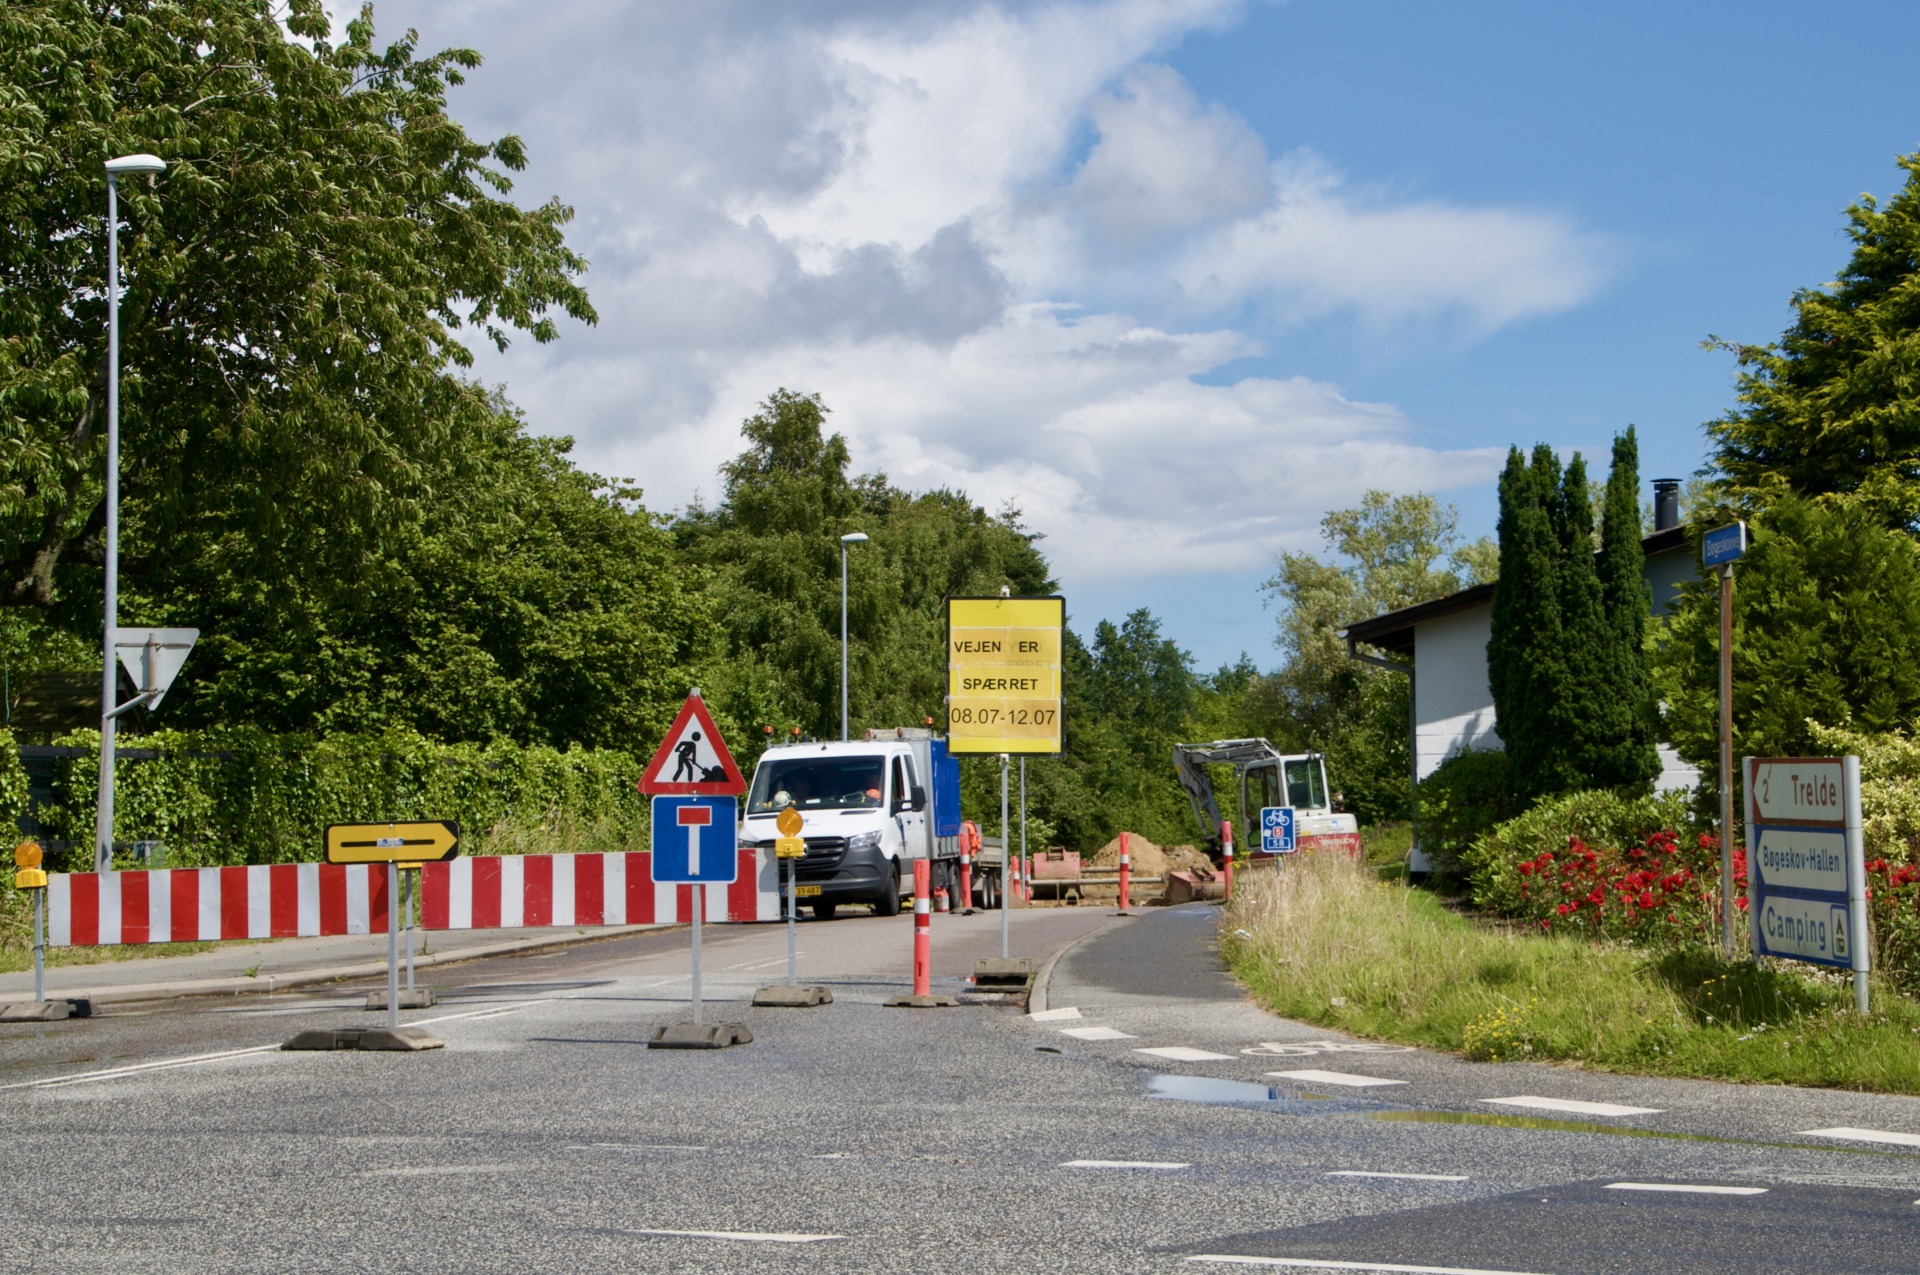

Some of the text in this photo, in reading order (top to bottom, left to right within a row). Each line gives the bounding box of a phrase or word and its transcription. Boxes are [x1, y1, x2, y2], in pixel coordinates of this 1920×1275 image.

[954, 641, 1039, 653] VEJEN ER
[963, 678, 1038, 690] SPÆRRET
[951, 708, 1056, 725] 08.07-12.07
[1762, 774, 1837, 806] 2 Trelde
[1763, 845, 1840, 872] Bøgeskov-Hallen
[1766, 906, 1826, 951] Camping
